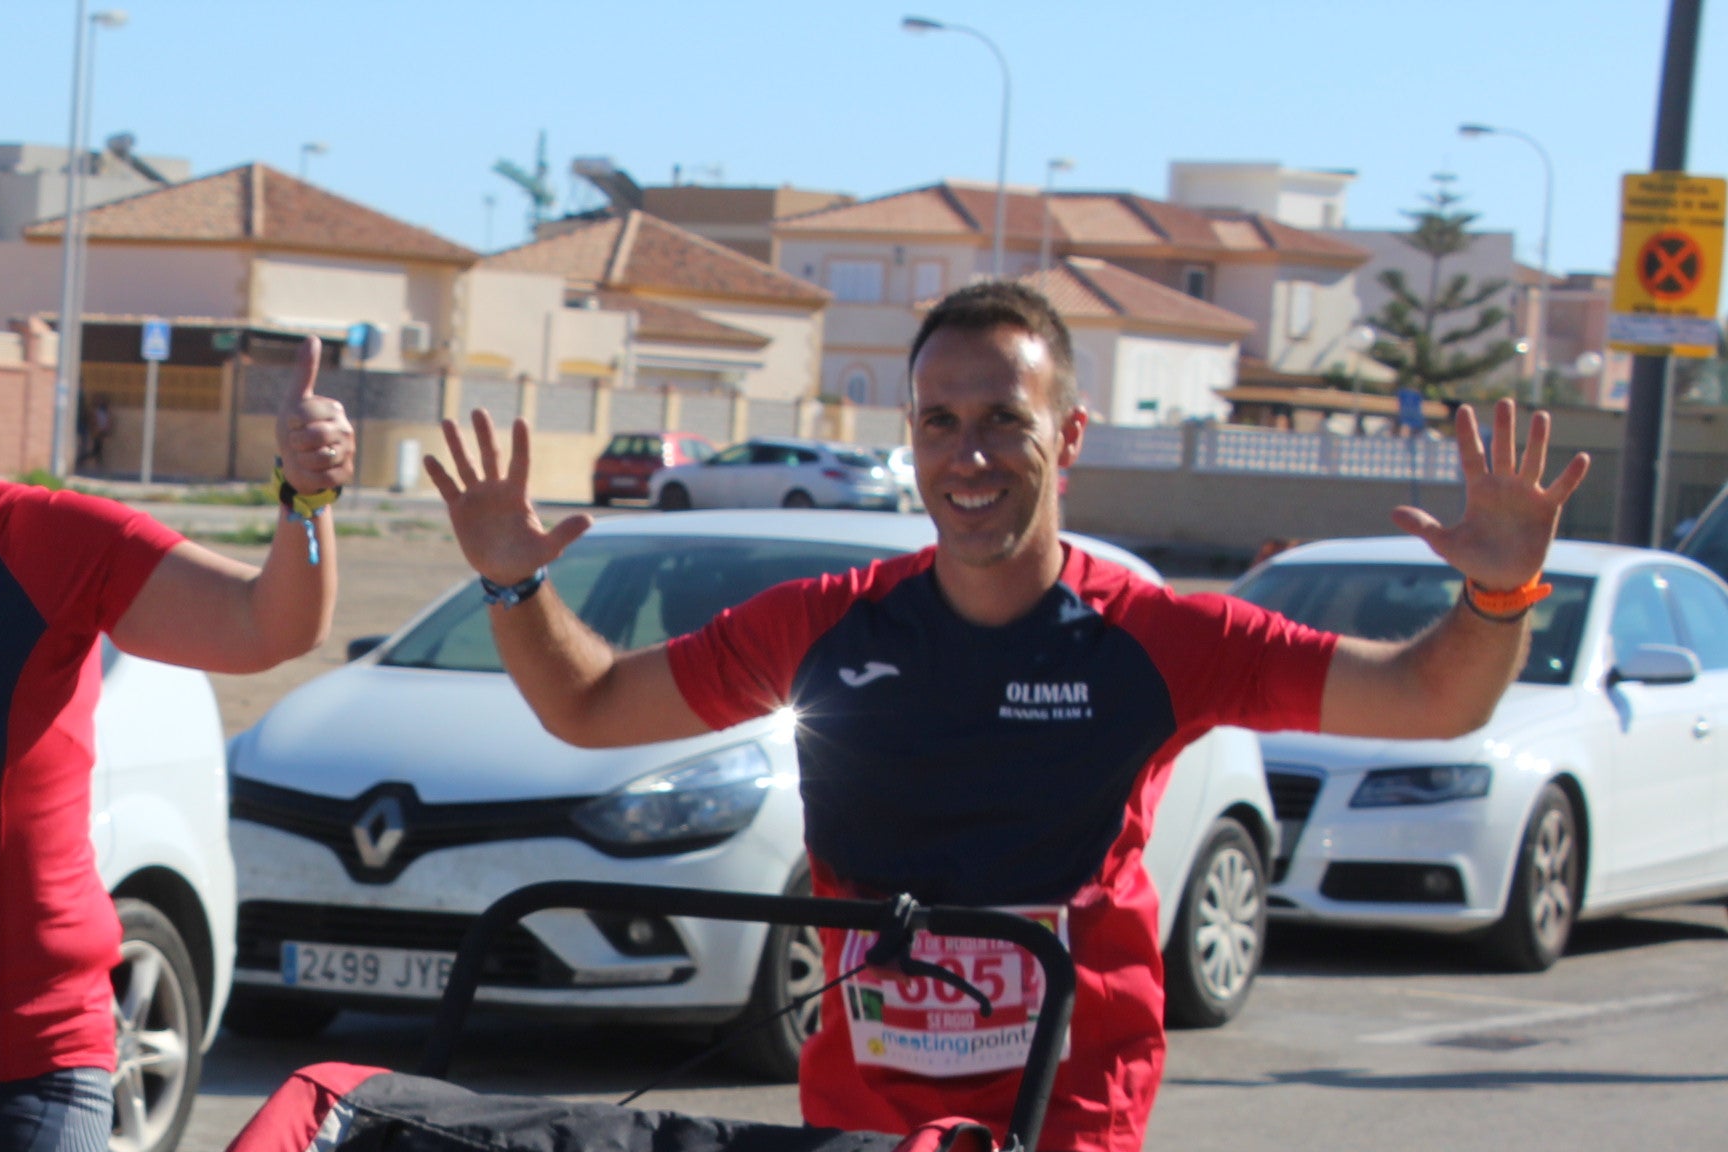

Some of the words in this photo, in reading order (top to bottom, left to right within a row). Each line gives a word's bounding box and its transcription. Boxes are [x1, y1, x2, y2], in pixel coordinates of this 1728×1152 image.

[1005, 681, 1089, 703] OLIMAR
[999, 705, 1049, 720] RUNNING
[1051, 707, 1081, 719] TEAM
[301, 947, 380, 985] 2499
